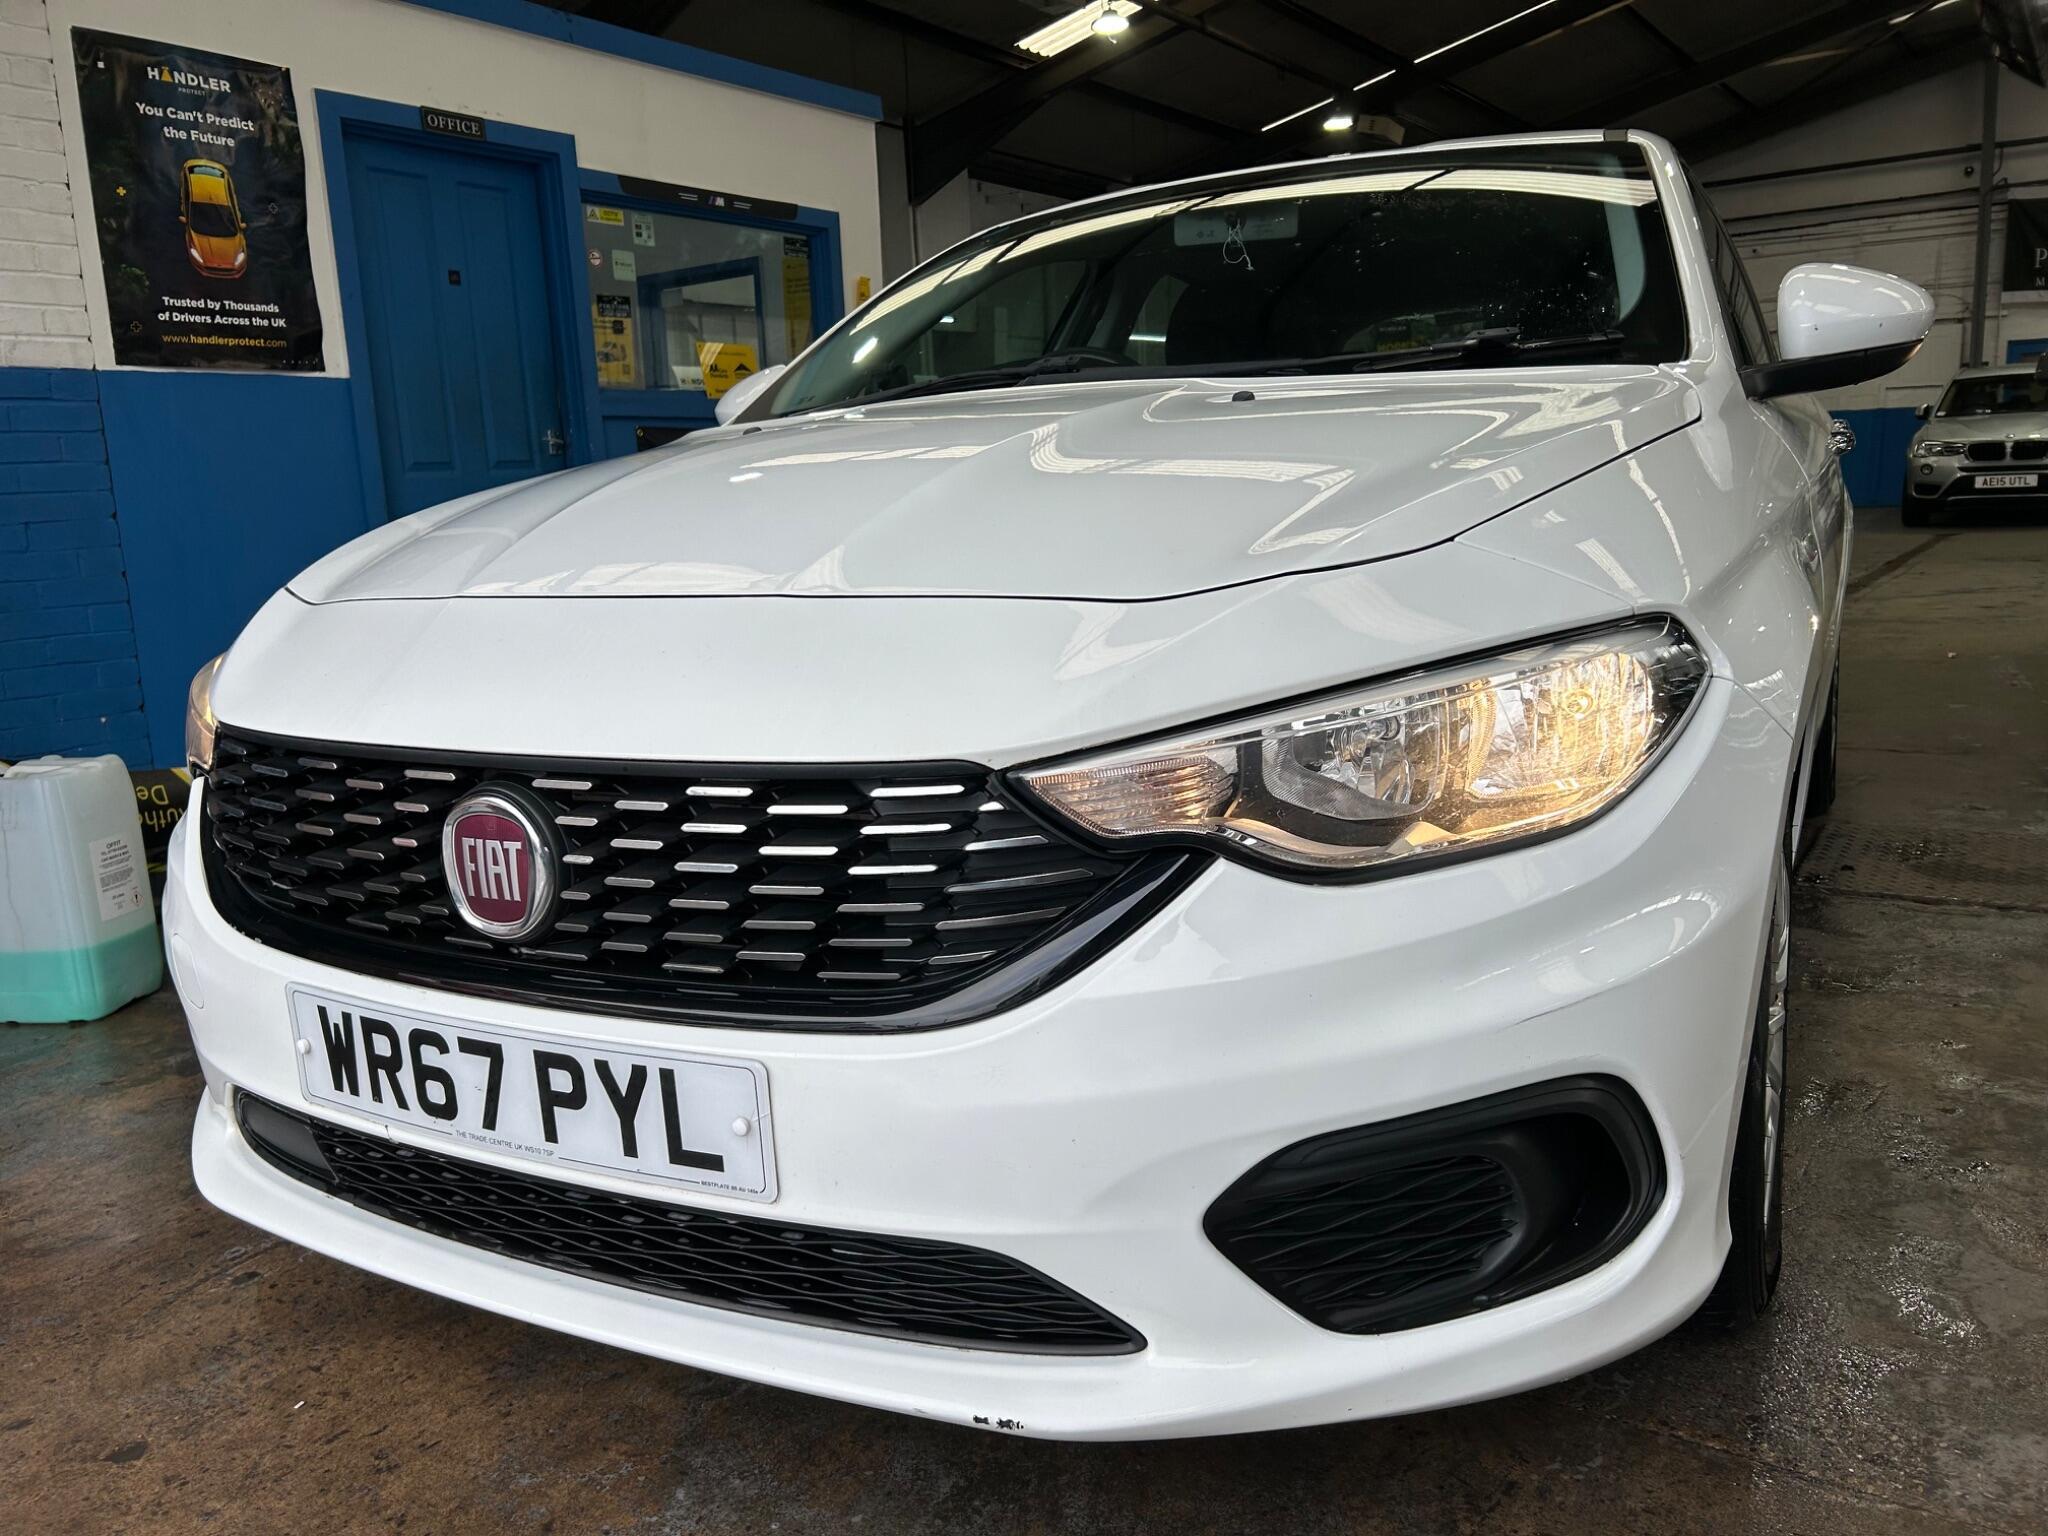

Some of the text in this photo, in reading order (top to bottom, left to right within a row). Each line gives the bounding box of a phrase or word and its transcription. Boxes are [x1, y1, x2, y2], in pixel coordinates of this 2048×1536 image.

[147, 65, 231, 93] HANDLER
[135, 102, 255, 131] You Can't Predict
[427, 114, 481, 135] OFFICE
[163, 126, 235, 146] the Future
[162, 296, 280, 313] Trusted by Thousands
[157, 312, 287, 327] of Drivers Across the UK
[162, 334, 287, 348] www.handlerprotect.com
[1983, 476, 2031, 487] AE15 UTL
[462, 837, 522, 902] FIAT
[317, 1005, 725, 1173] WR67 PYL
[456, 1130, 467, 1139] THE
[468, 1132, 487, 1144] TRADE
[488, 1137, 513, 1149] CENTRE
[514, 1143, 523, 1151] UK
